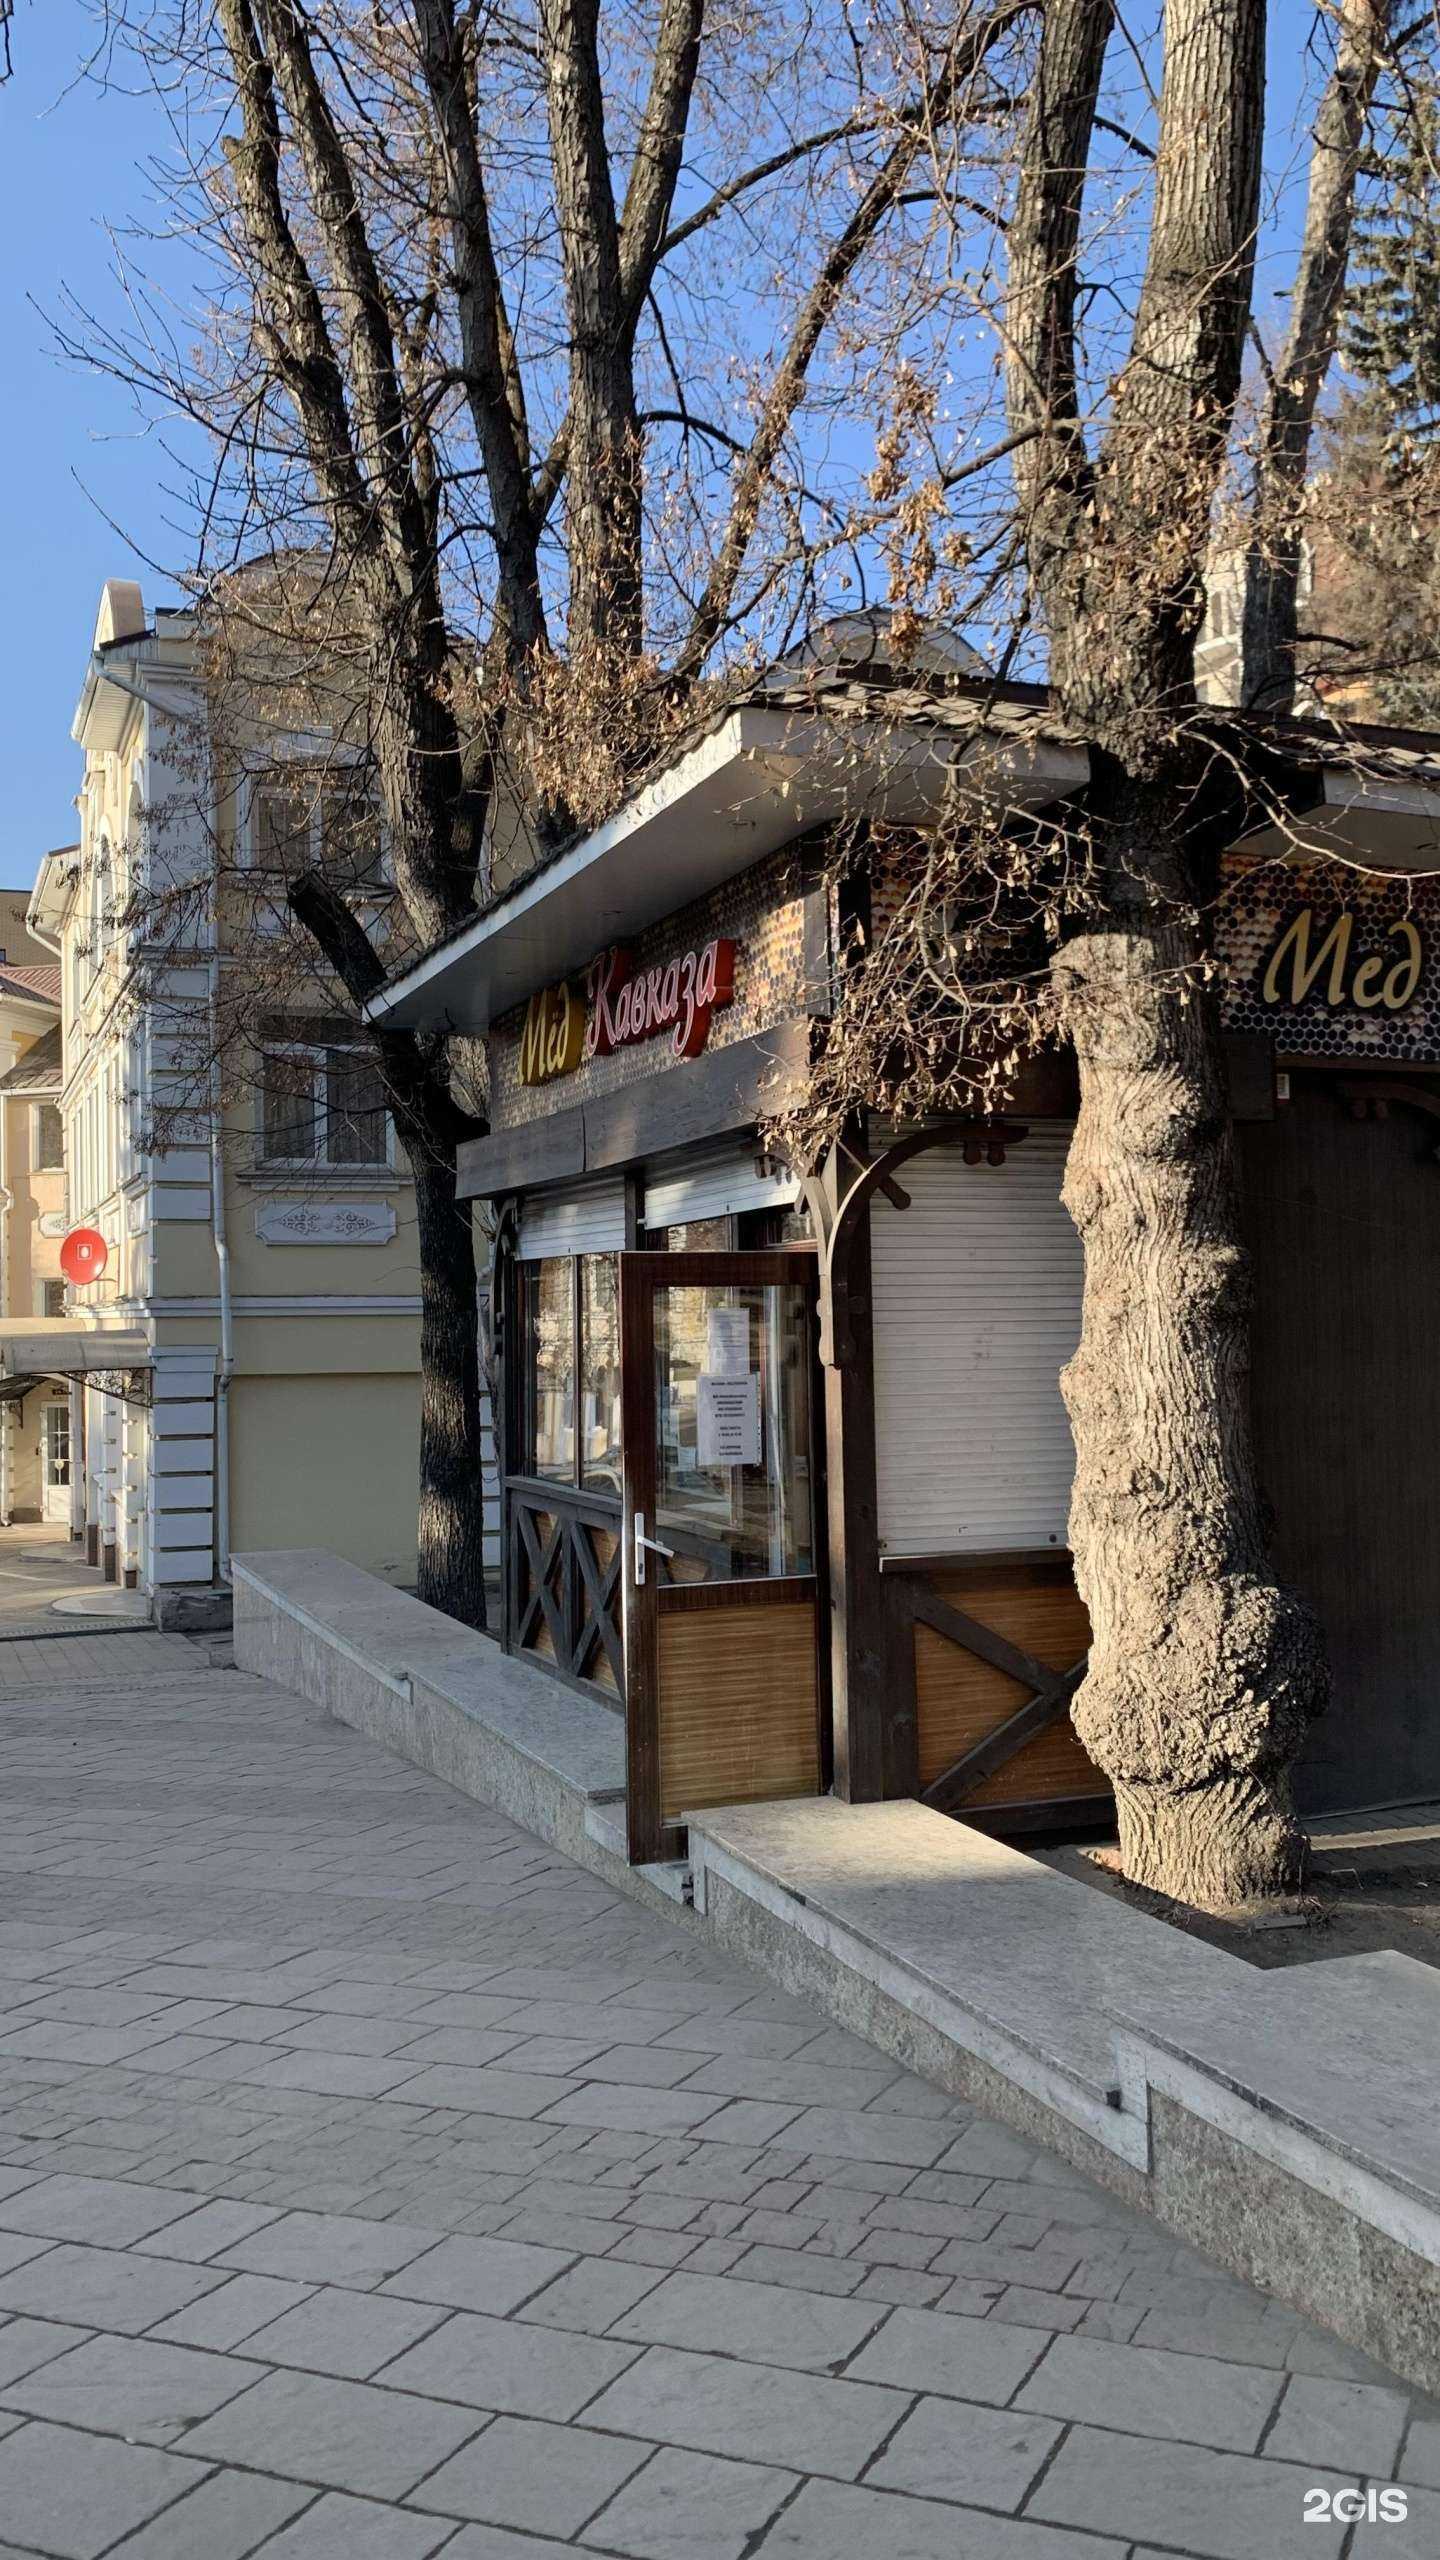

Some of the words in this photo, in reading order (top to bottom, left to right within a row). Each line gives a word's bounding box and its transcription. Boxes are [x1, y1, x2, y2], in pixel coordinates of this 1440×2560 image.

[518, 981, 570, 1085] Мёд
[587, 939, 717, 1058] Кавказа
[1263, 909, 1422, 1009] Мед
